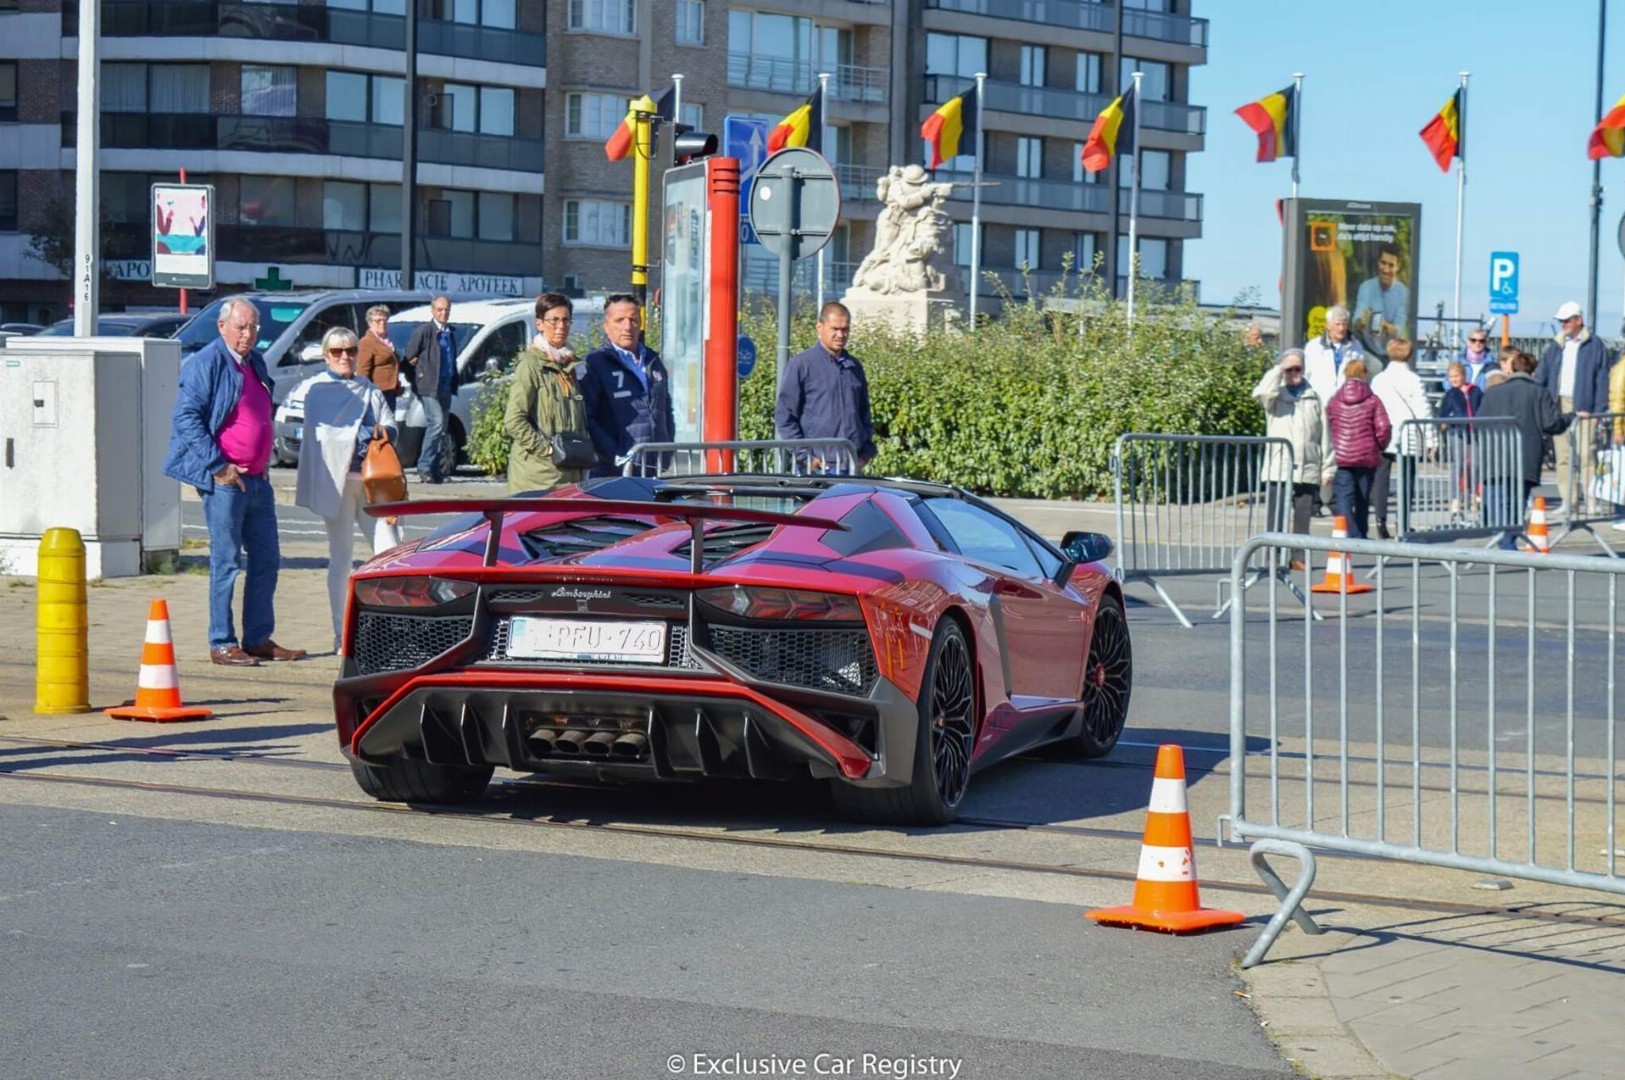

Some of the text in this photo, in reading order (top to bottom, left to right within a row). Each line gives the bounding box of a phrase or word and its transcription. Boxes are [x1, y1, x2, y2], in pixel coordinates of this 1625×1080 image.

[365, 270, 520, 294] PHARACIE APOTEEK
[1493, 258, 1515, 292] P
[611, 370, 625, 389] 7
[551, 586, 612, 600] Lamborghini
